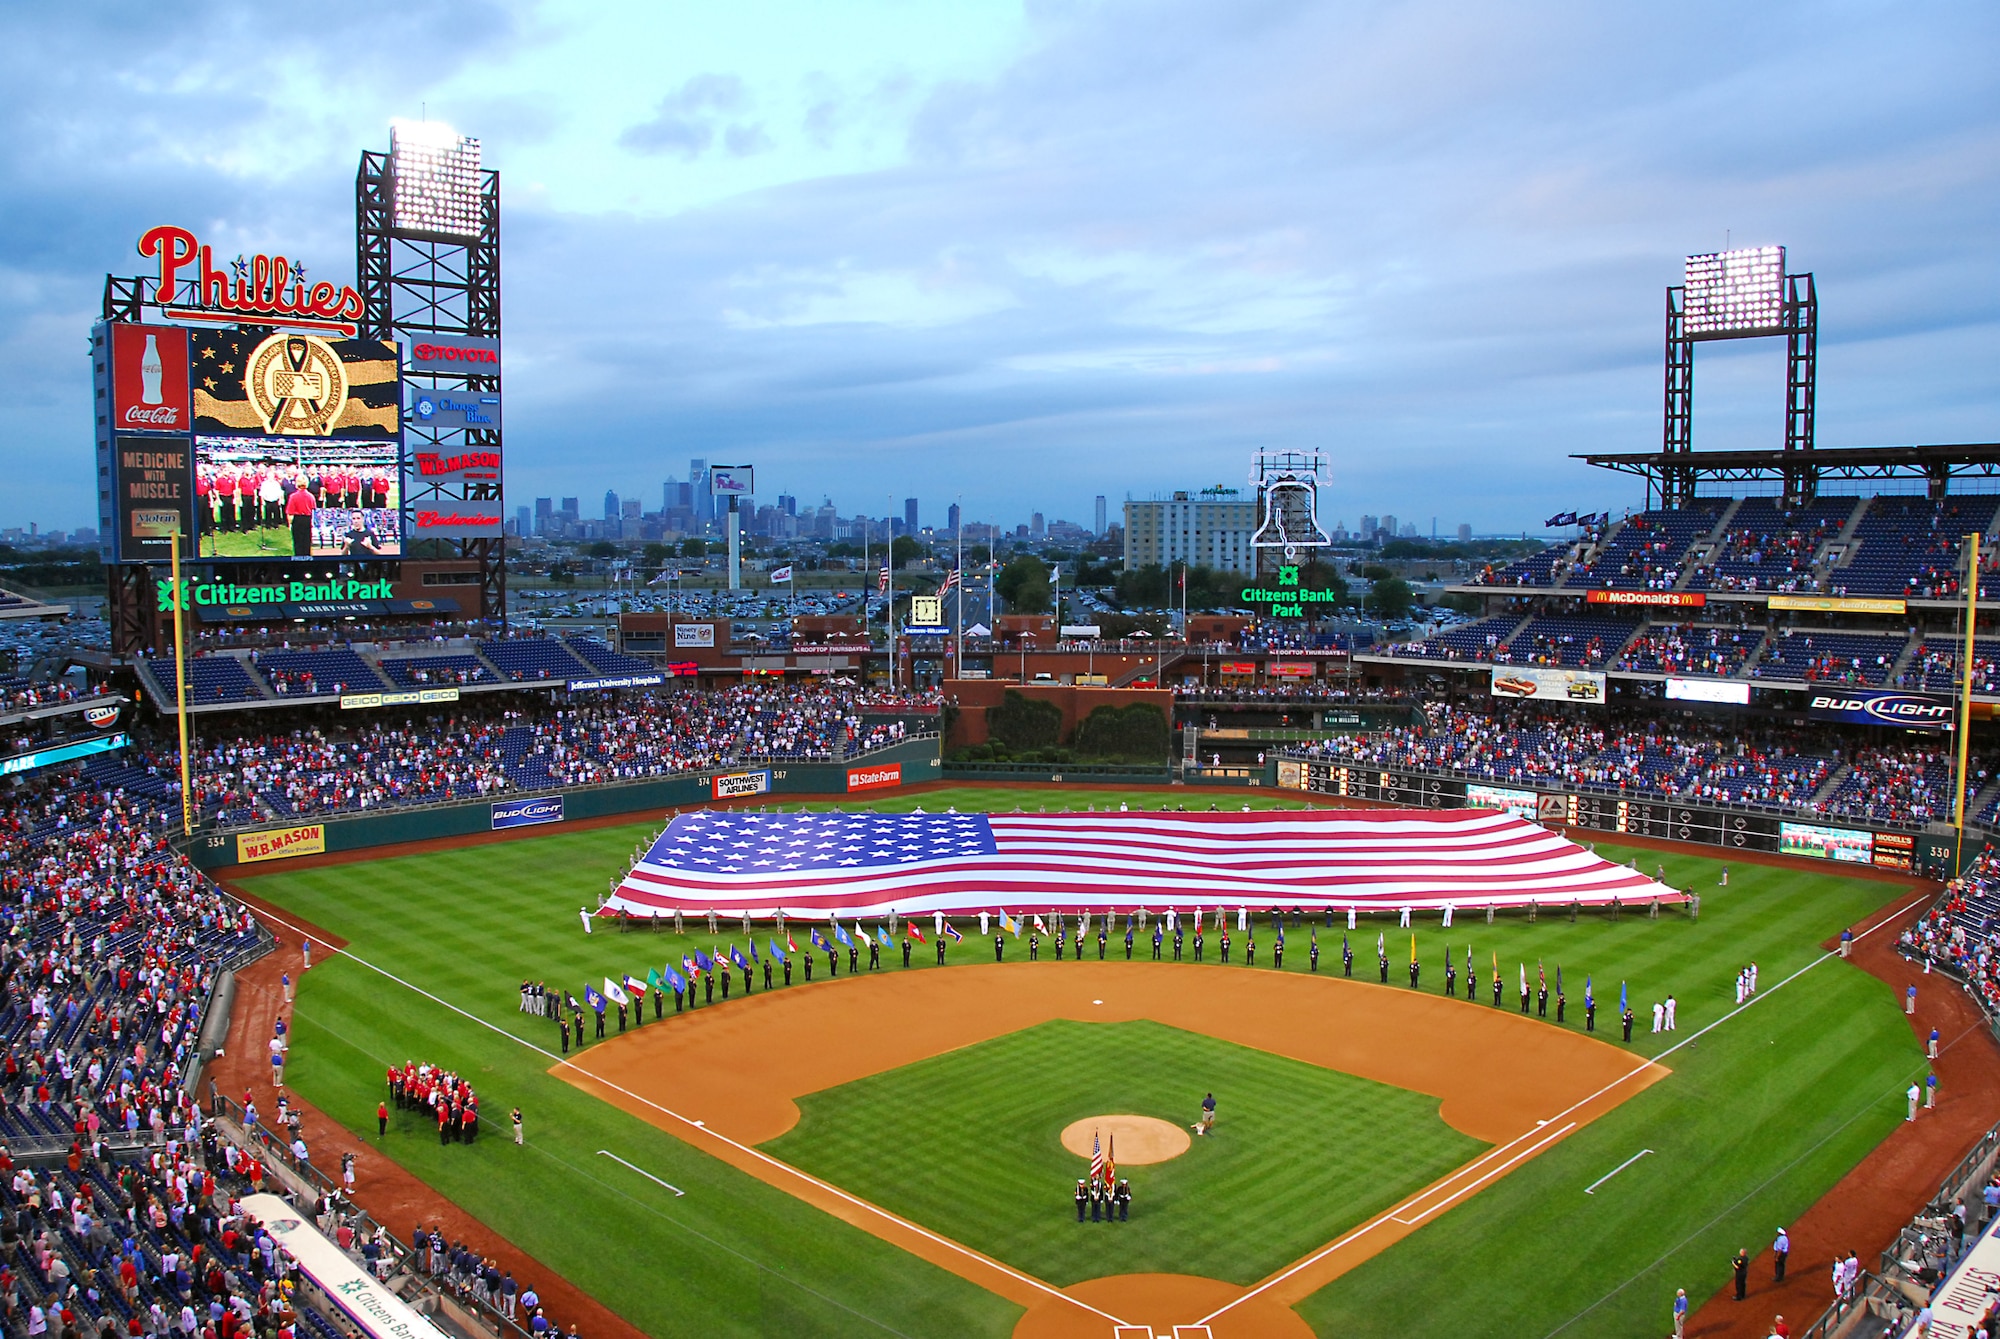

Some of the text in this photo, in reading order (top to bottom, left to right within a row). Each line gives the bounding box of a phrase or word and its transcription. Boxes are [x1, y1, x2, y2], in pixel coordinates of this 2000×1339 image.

[138, 225, 365, 321] Phillies
[435, 345, 498, 364] TOYOTA
[439, 399, 479, 411] Choose
[125, 405, 179, 424] Coca-Cola
[130, 482, 181, 498] MUSCLE
[137, 513, 176, 523] Motrin
[416, 510, 500, 528] Budweiser
[195, 577, 393, 605] Citizens Bank Park
[1241, 588, 1335, 602] Citizens Bank
[1609, 592, 1680, 604] McDonald's
[299, 604, 336, 612] HARRY
[1272, 603, 1303, 617] Park
[1770, 599, 1817, 607] AutoTrader
[1838, 600, 1890, 609] AutoTrader
[677, 632, 696, 640] Nine
[570, 675, 661, 691] Jefferson University Hospitals
[342, 691, 457, 706] GEICO GEICO GEICO
[88, 706, 118, 720] Gulf
[1810, 696, 1953, 717] BUD LIGHT
[3, 755, 36, 774] PARK
[930, 758, 941, 767] 409
[719, 774, 764, 787] SOUTHWEST
[726, 783, 759, 794] AIRLINES
[494, 804, 561, 819] BUD LIGHT
[1875, 833, 1912, 844] MODELL'S
[295, 845, 320, 853] Products
[1930, 846, 1950, 858] 330
[356, 1292, 396, 1325] Citizens
